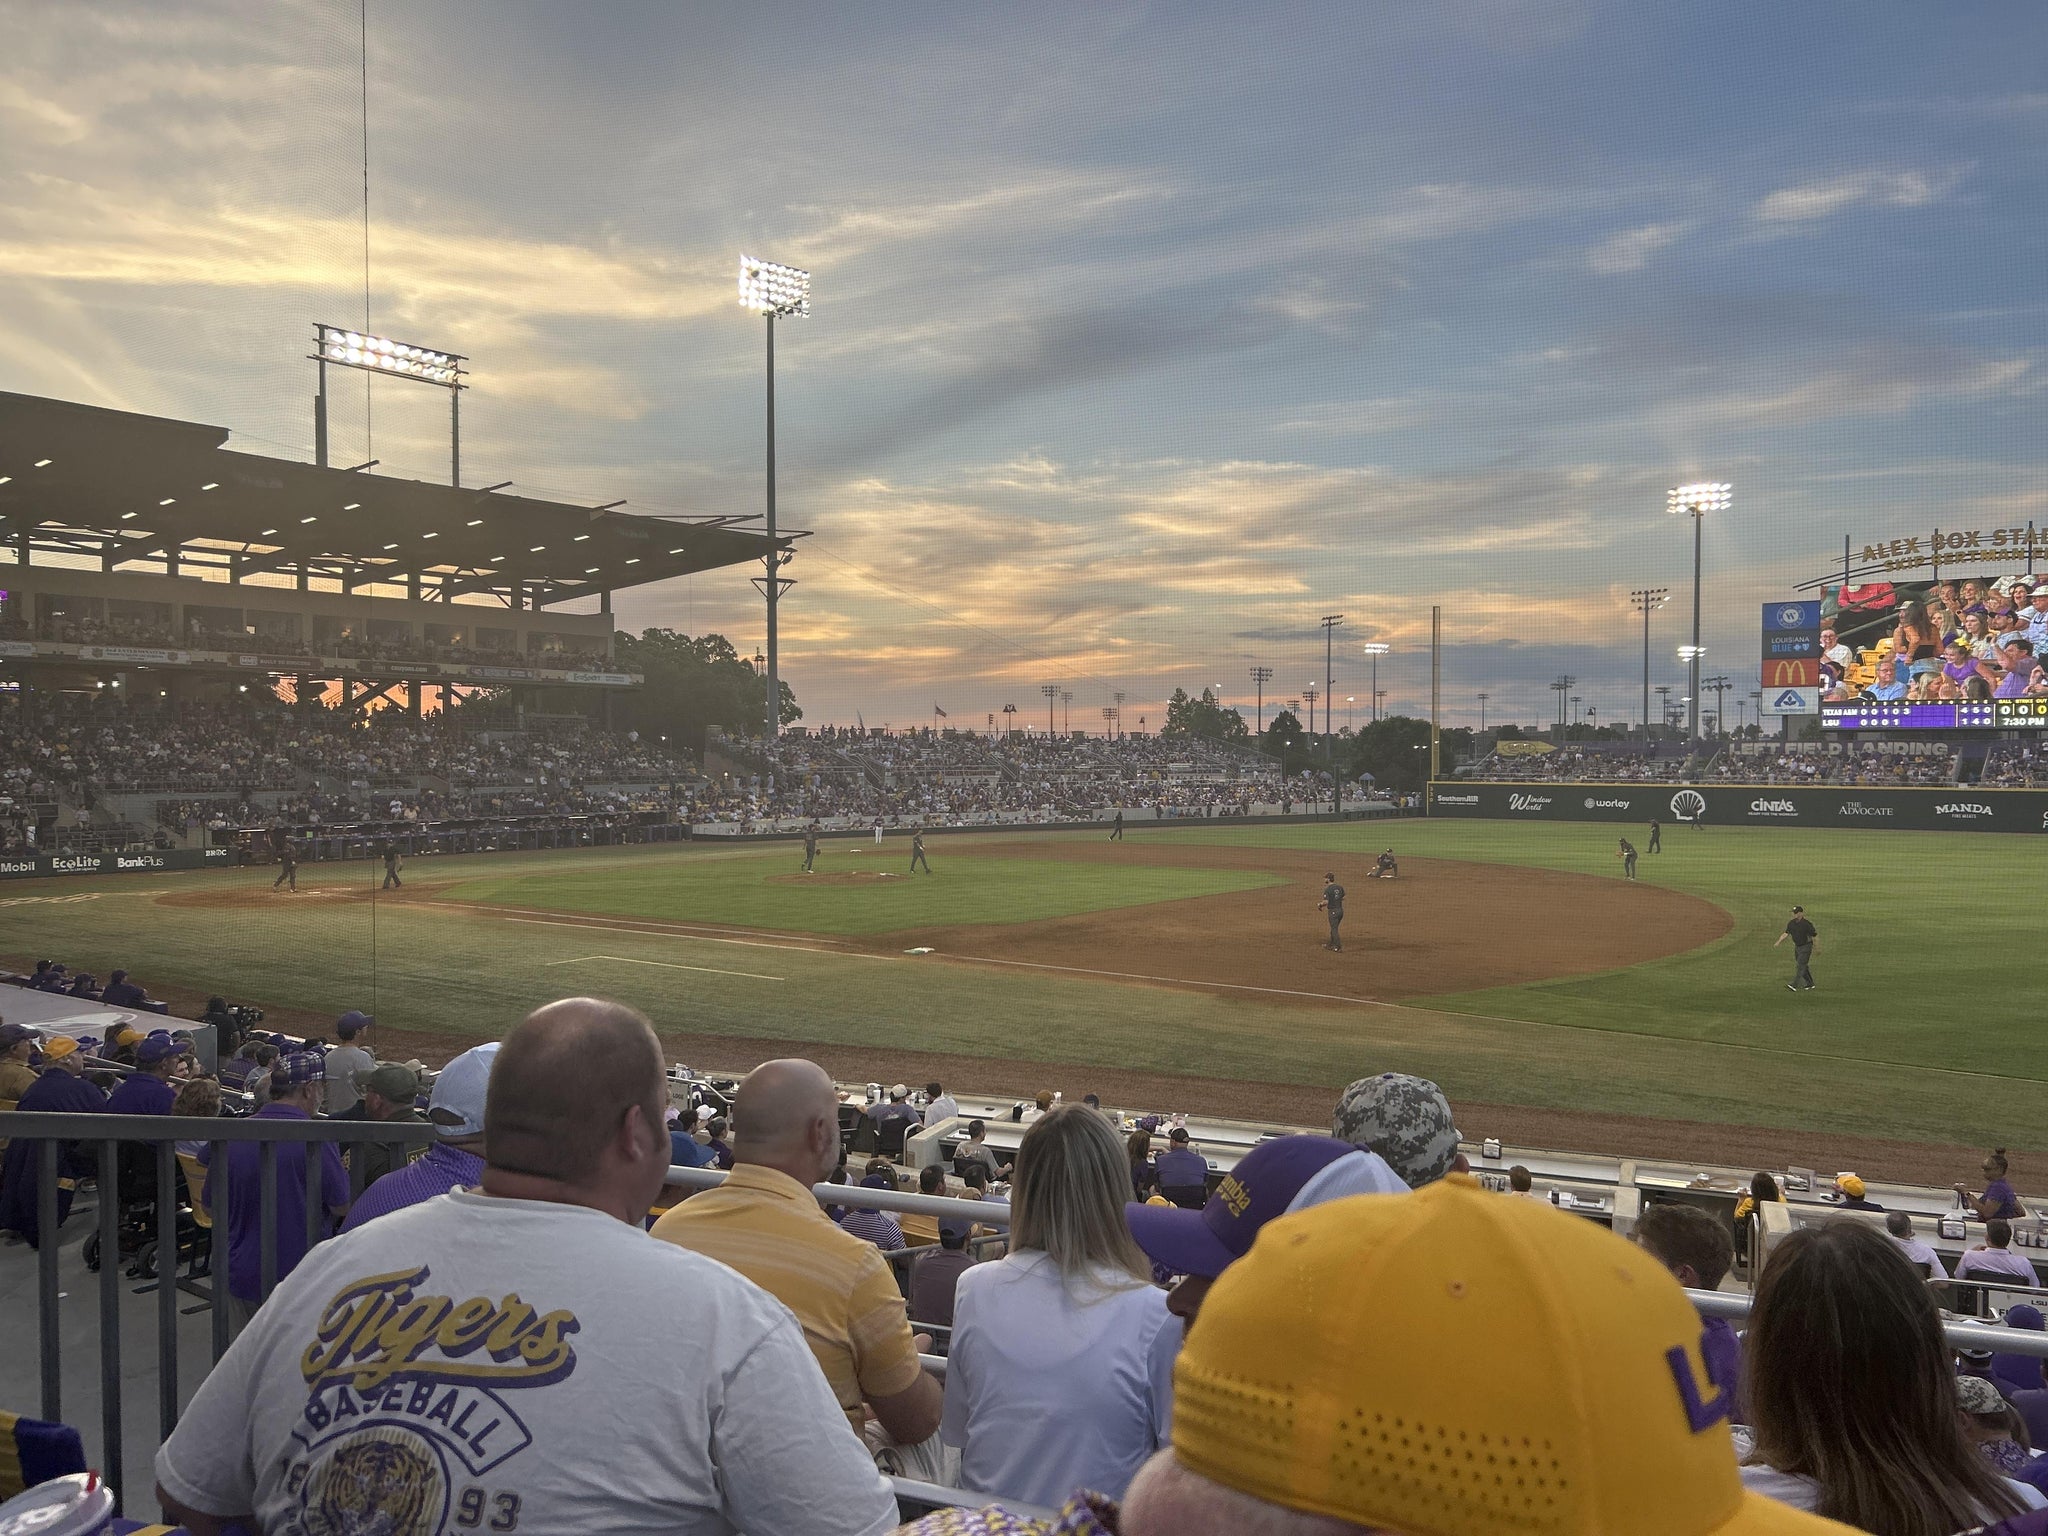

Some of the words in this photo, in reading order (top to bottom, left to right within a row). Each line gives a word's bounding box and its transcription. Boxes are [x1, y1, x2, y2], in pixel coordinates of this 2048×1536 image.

[1862, 536, 1920, 562] ALEX
[1931, 530, 1981, 551] BOX
[1883, 555, 1925, 573] SKIP
[1931, 548, 2025, 566] BERTMAN
[1771, 636, 1810, 644] LOUISIANA
[1772, 643, 1792, 653] BLUE
[1822, 708, 1842, 716] TEXAS
[2001, 705, 2011, 715] 0
[2019, 705, 2029, 715] 0
[2037, 705, 2047, 715] 0
[1822, 719, 1840, 727] LSU
[2002, 717, 2026, 726] 7:30
[2027, 717, 2045, 726] PM
[1729, 742, 1781, 756] LEFT
[1785, 742, 1843, 756] FIELD
[1848, 742, 1949, 756] LANDING
[1509, 793, 1552, 810] Window
[1595, 799, 1630, 810] worley
[1839, 805, 1894, 816] ADVOCATE
[1935, 803, 1993, 816] MANDA
[0, 861, 36, 873] Mobil
[52, 856, 101, 869] EcoLite
[117, 855, 164, 868] BankPlus
[302, 1264, 582, 1398] Tigers
[304, 1380, 501, 1459] BASEBALL
[456, 1485, 522, 1532] 93
